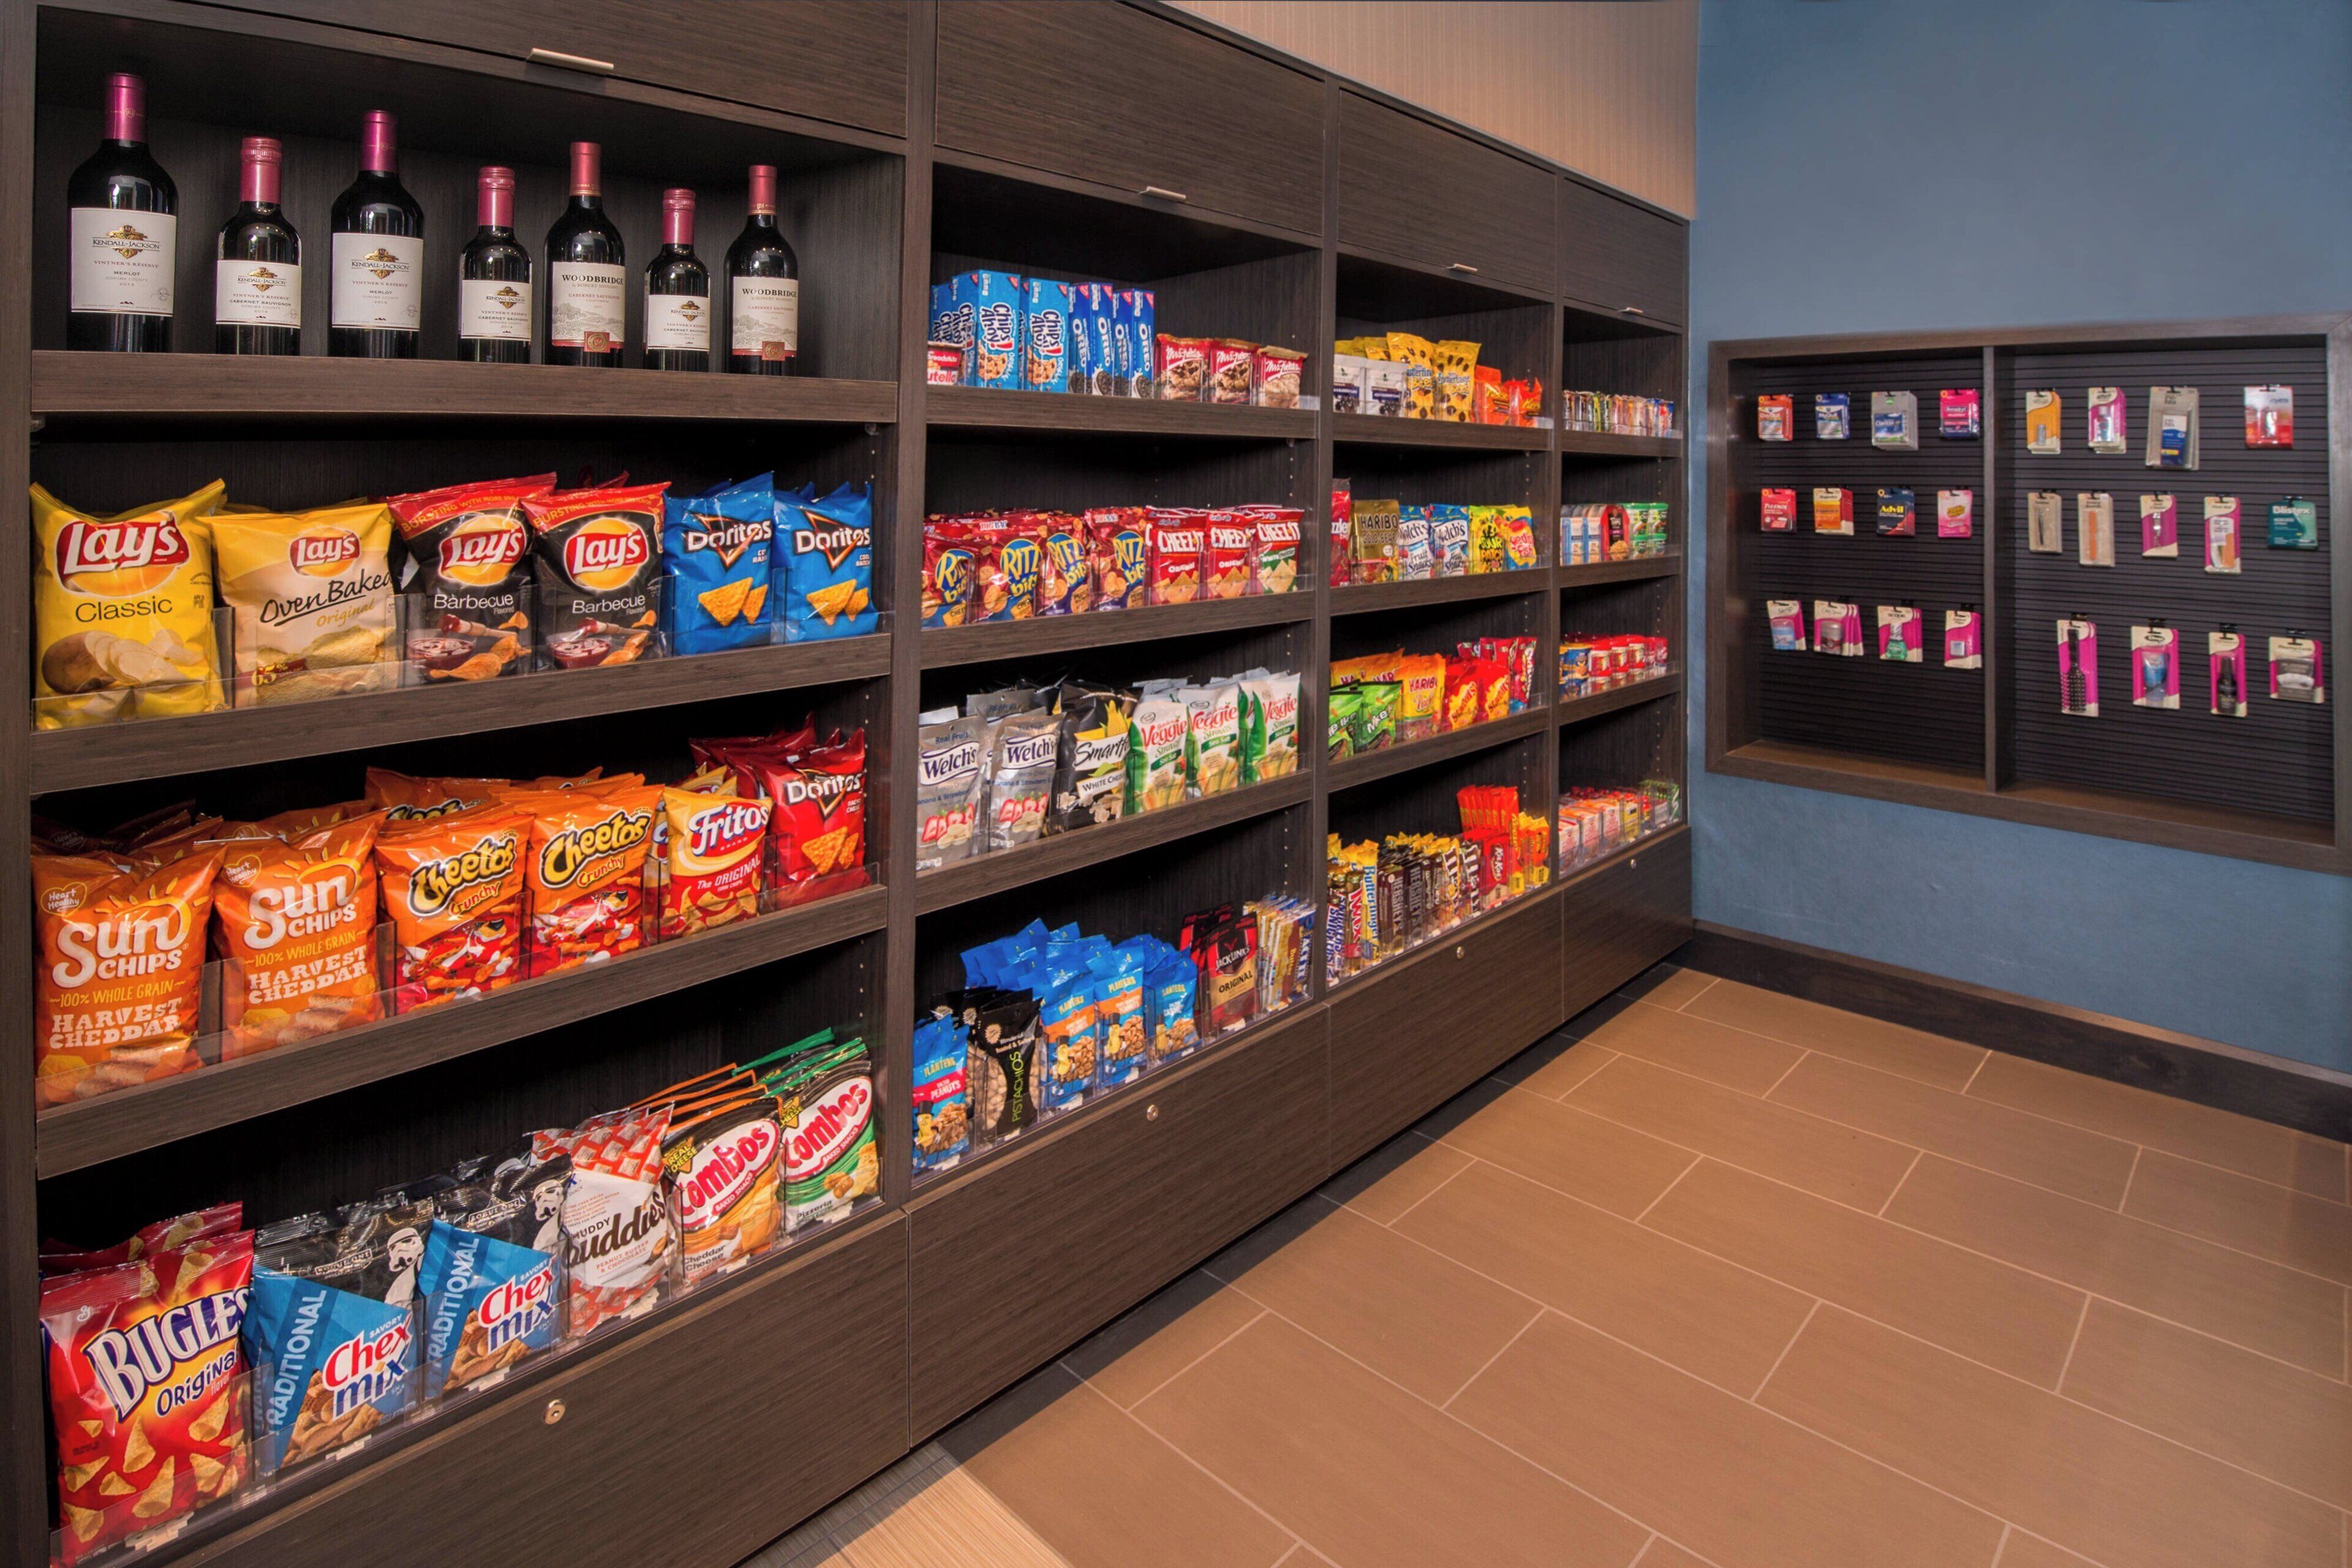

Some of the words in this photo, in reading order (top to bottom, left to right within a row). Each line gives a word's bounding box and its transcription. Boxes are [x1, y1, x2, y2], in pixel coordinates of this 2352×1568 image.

[92, 239, 160, 249] KENDALL-JACKSON
[351, 262, 409, 270] KENDALL-JACKSON
[562, 274, 624, 285] WOODBRIDGE
[742, 288, 797, 298] WOODBRIDGE
[993, 303, 1012, 342] Chips
[1042, 311, 1061, 347] Chips
[1073, 318, 1087, 367] OREO
[1098, 317, 1110, 367] OREO
[1115, 324, 1128, 371] OREO
[1139, 323, 1150, 371] OREO
[402, 503, 458, 533] BURSTING
[461, 497, 482, 508] WITH
[533, 502, 584, 528] BURSTING
[1359, 514, 1398, 530] HARIBO
[1880, 505, 1904, 514] Advil
[2272, 505, 2312, 516] Blistex
[64, 518, 179, 575] Lay's
[296, 535, 356, 568] Lay's
[446, 529, 522, 569] Lay's
[687, 520, 773, 552] Doritos
[795, 527, 870, 554] Doritos
[573, 532, 643, 575] Lay's
[1001, 545, 1040, 581] RITZ
[1112, 537, 1145, 569] RITZ
[75, 595, 173, 624] Classic
[259, 592, 327, 624] Oven
[315, 598, 375, 628] Original
[434, 594, 514, 610] Barbecue
[572, 595, 646, 614] Barbecue
[1188, 705, 1238, 733] Veggie
[1262, 695, 1297, 725] Veggie
[936, 736, 951, 745] Real
[951, 731, 969, 742] Fruit
[1008, 737, 1055, 763] Welch's
[1141, 719, 1188, 750] Veggie
[922, 745, 978, 779] Welch's
[786, 772, 862, 804] Doritos
[1082, 780, 1107, 792] WHITE
[688, 804, 770, 858] Fritos
[720, 837, 748, 851] BRAND
[540, 810, 650, 888] Cheetos
[226, 861, 251, 877] Heart
[228, 868, 257, 884] Healthy
[409, 836, 516, 915] Cheetos
[576, 854, 625, 888] Crunchy
[698, 878, 713, 889] The
[714, 853, 761, 886] ORIGINAL
[48, 896, 80, 910] Healthy
[49, 889, 77, 901] Heart
[448, 881, 502, 916] Crunchy
[1363, 865, 1378, 939] Butterfinger
[244, 873, 356, 950] Sun
[287, 903, 357, 938] CHIPS
[52, 907, 189, 989] Sun
[97, 948, 183, 980] CHIPS
[254, 952, 284, 967] 100%
[286, 941, 324, 960] WHOLE
[325, 930, 356, 951] GRAIN
[1215, 954, 1232, 971] JACK
[1232, 944, 1251, 963] LINK'S
[249, 944, 368, 990] HARVEST
[249, 960, 368, 1005] CHEDDAR
[1218, 970, 1253, 993] ORIGINAL
[60, 991, 89, 1008] 100%
[92, 987, 134, 1006] WHOLE
[137, 979, 174, 999] GRAIN
[1108, 976, 1137, 993] PLANTERS
[51, 997, 183, 1033] HARVEST
[49, 1014, 181, 1050] CHEDDAR
[924, 1057, 956, 1078] PLANTERS
[930, 1080, 962, 1101] PEANUTS
[1009, 1050, 1024, 1123] PISTACHIOS
[782, 1084, 867, 1169] Combos
[668, 1144, 691, 1165] REAL
[671, 1147, 698, 1173] CHEESE
[821, 1147, 842, 1165] BAKED
[840, 1125, 859, 1150] SNACKS
[677, 1127, 771, 1216] Combos
[715, 1195, 735, 1213] BAKED
[734, 1172, 755, 1197] SNACKS
[796, 1199, 833, 1220] Pizzeria
[564, 1190, 666, 1270] buddies
[353, 1250, 372, 1264] ONE
[520, 1259, 548, 1281] SAVORY
[595, 1251, 624, 1270] PEANUT
[624, 1239, 650, 1260] BUTTER
[606, 1246, 648, 1272] CHOCOLATE
[684, 1244, 726, 1264] Cheddar
[685, 1253, 724, 1272] Cheese
[428, 1237, 480, 1368] TRADITIONAL
[479, 1265, 554, 1325] Chex
[370, 1314, 402, 1338] SAVORY
[490, 1292, 553, 1351] mix
[86, 1290, 249, 1420] BUGLES
[325, 1313, 412, 1387] Chex
[211, 1372, 230, 1396] flavor
[335, 1345, 409, 1417] mix
